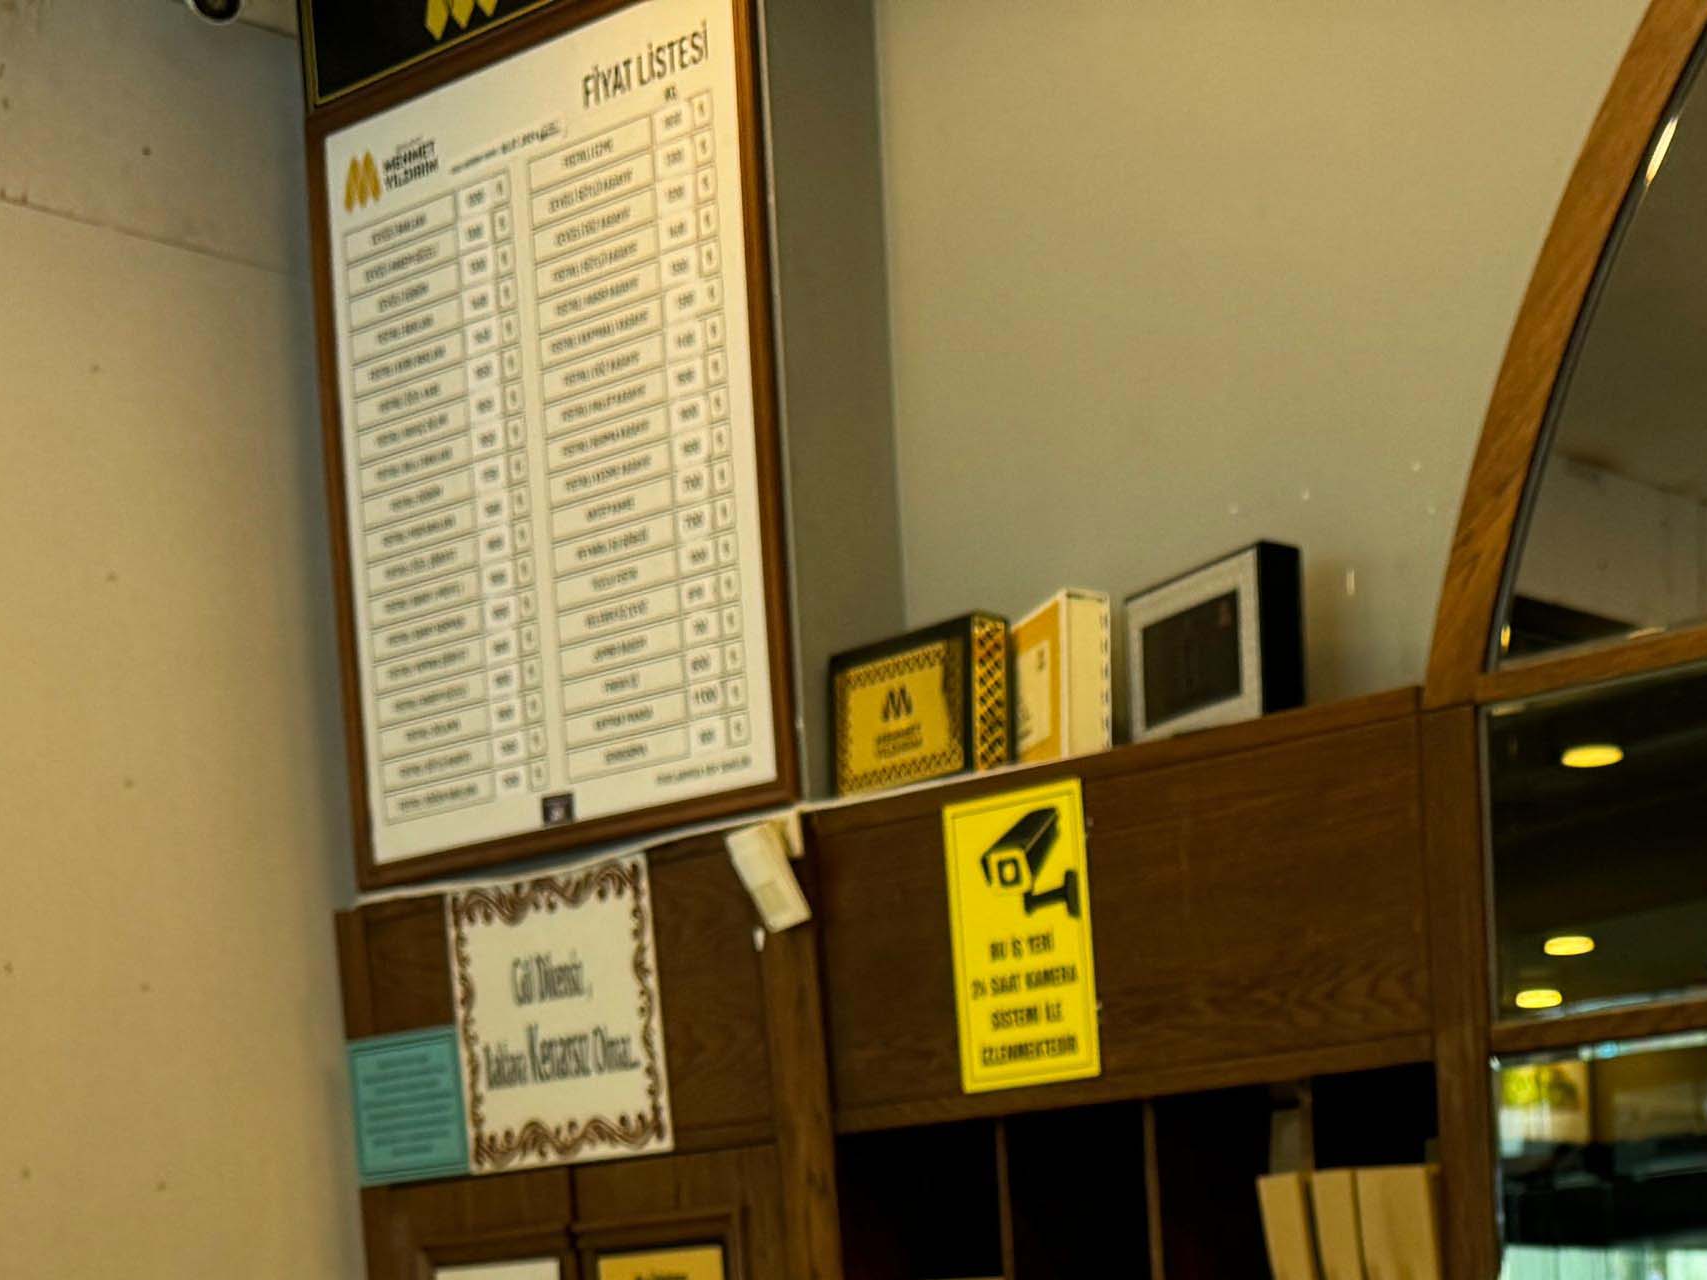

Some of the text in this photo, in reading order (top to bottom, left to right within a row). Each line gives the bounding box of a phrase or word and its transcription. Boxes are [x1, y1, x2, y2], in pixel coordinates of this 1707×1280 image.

[582, 20, 709, 109] FİYAT LİSTESİ
[990, 974, 1020, 997] SAAT
[1025, 965, 1078, 990] KAMERA
